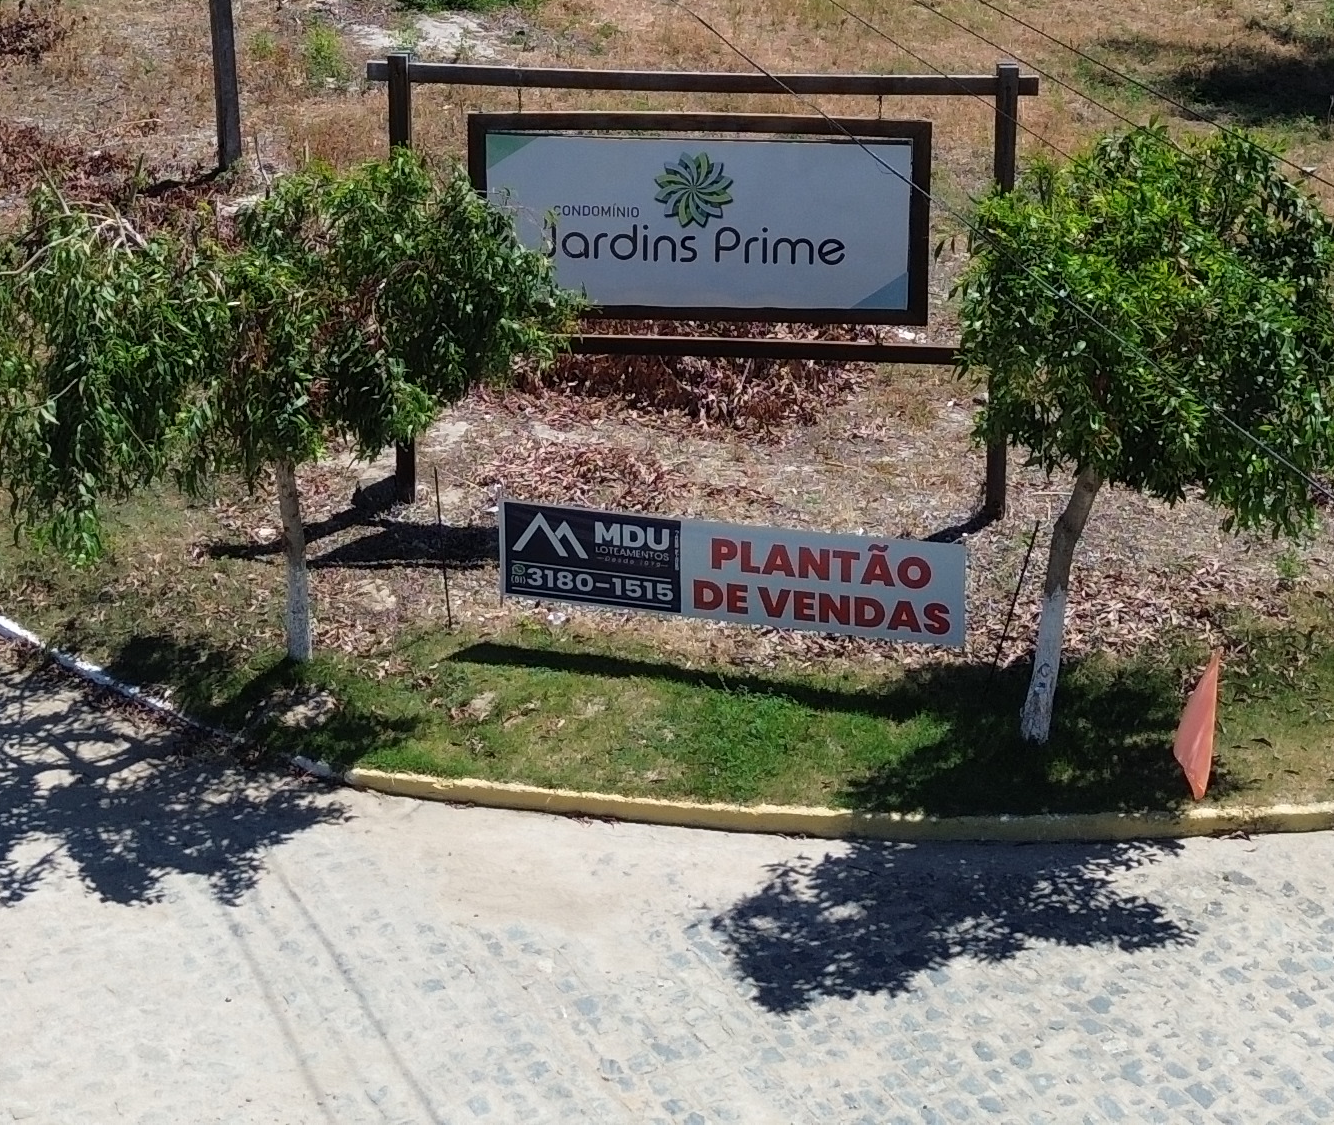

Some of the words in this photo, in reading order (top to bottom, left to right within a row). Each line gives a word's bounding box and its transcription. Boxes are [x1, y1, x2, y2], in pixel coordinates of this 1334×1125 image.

[553, 203, 640, 218] CONDOMÍNIO
[541, 223, 698, 263] Jardins
[714, 226, 846, 265] Prime
[594, 521, 670, 551] MDU
[595, 546, 670, 562] LOTEAMENTOS
[711, 537, 932, 589] PLANTÃO
[527, 567, 674, 601] 3180-1515
[693, 579, 749, 614] DE
[757, 586, 951, 635] VENDAS
